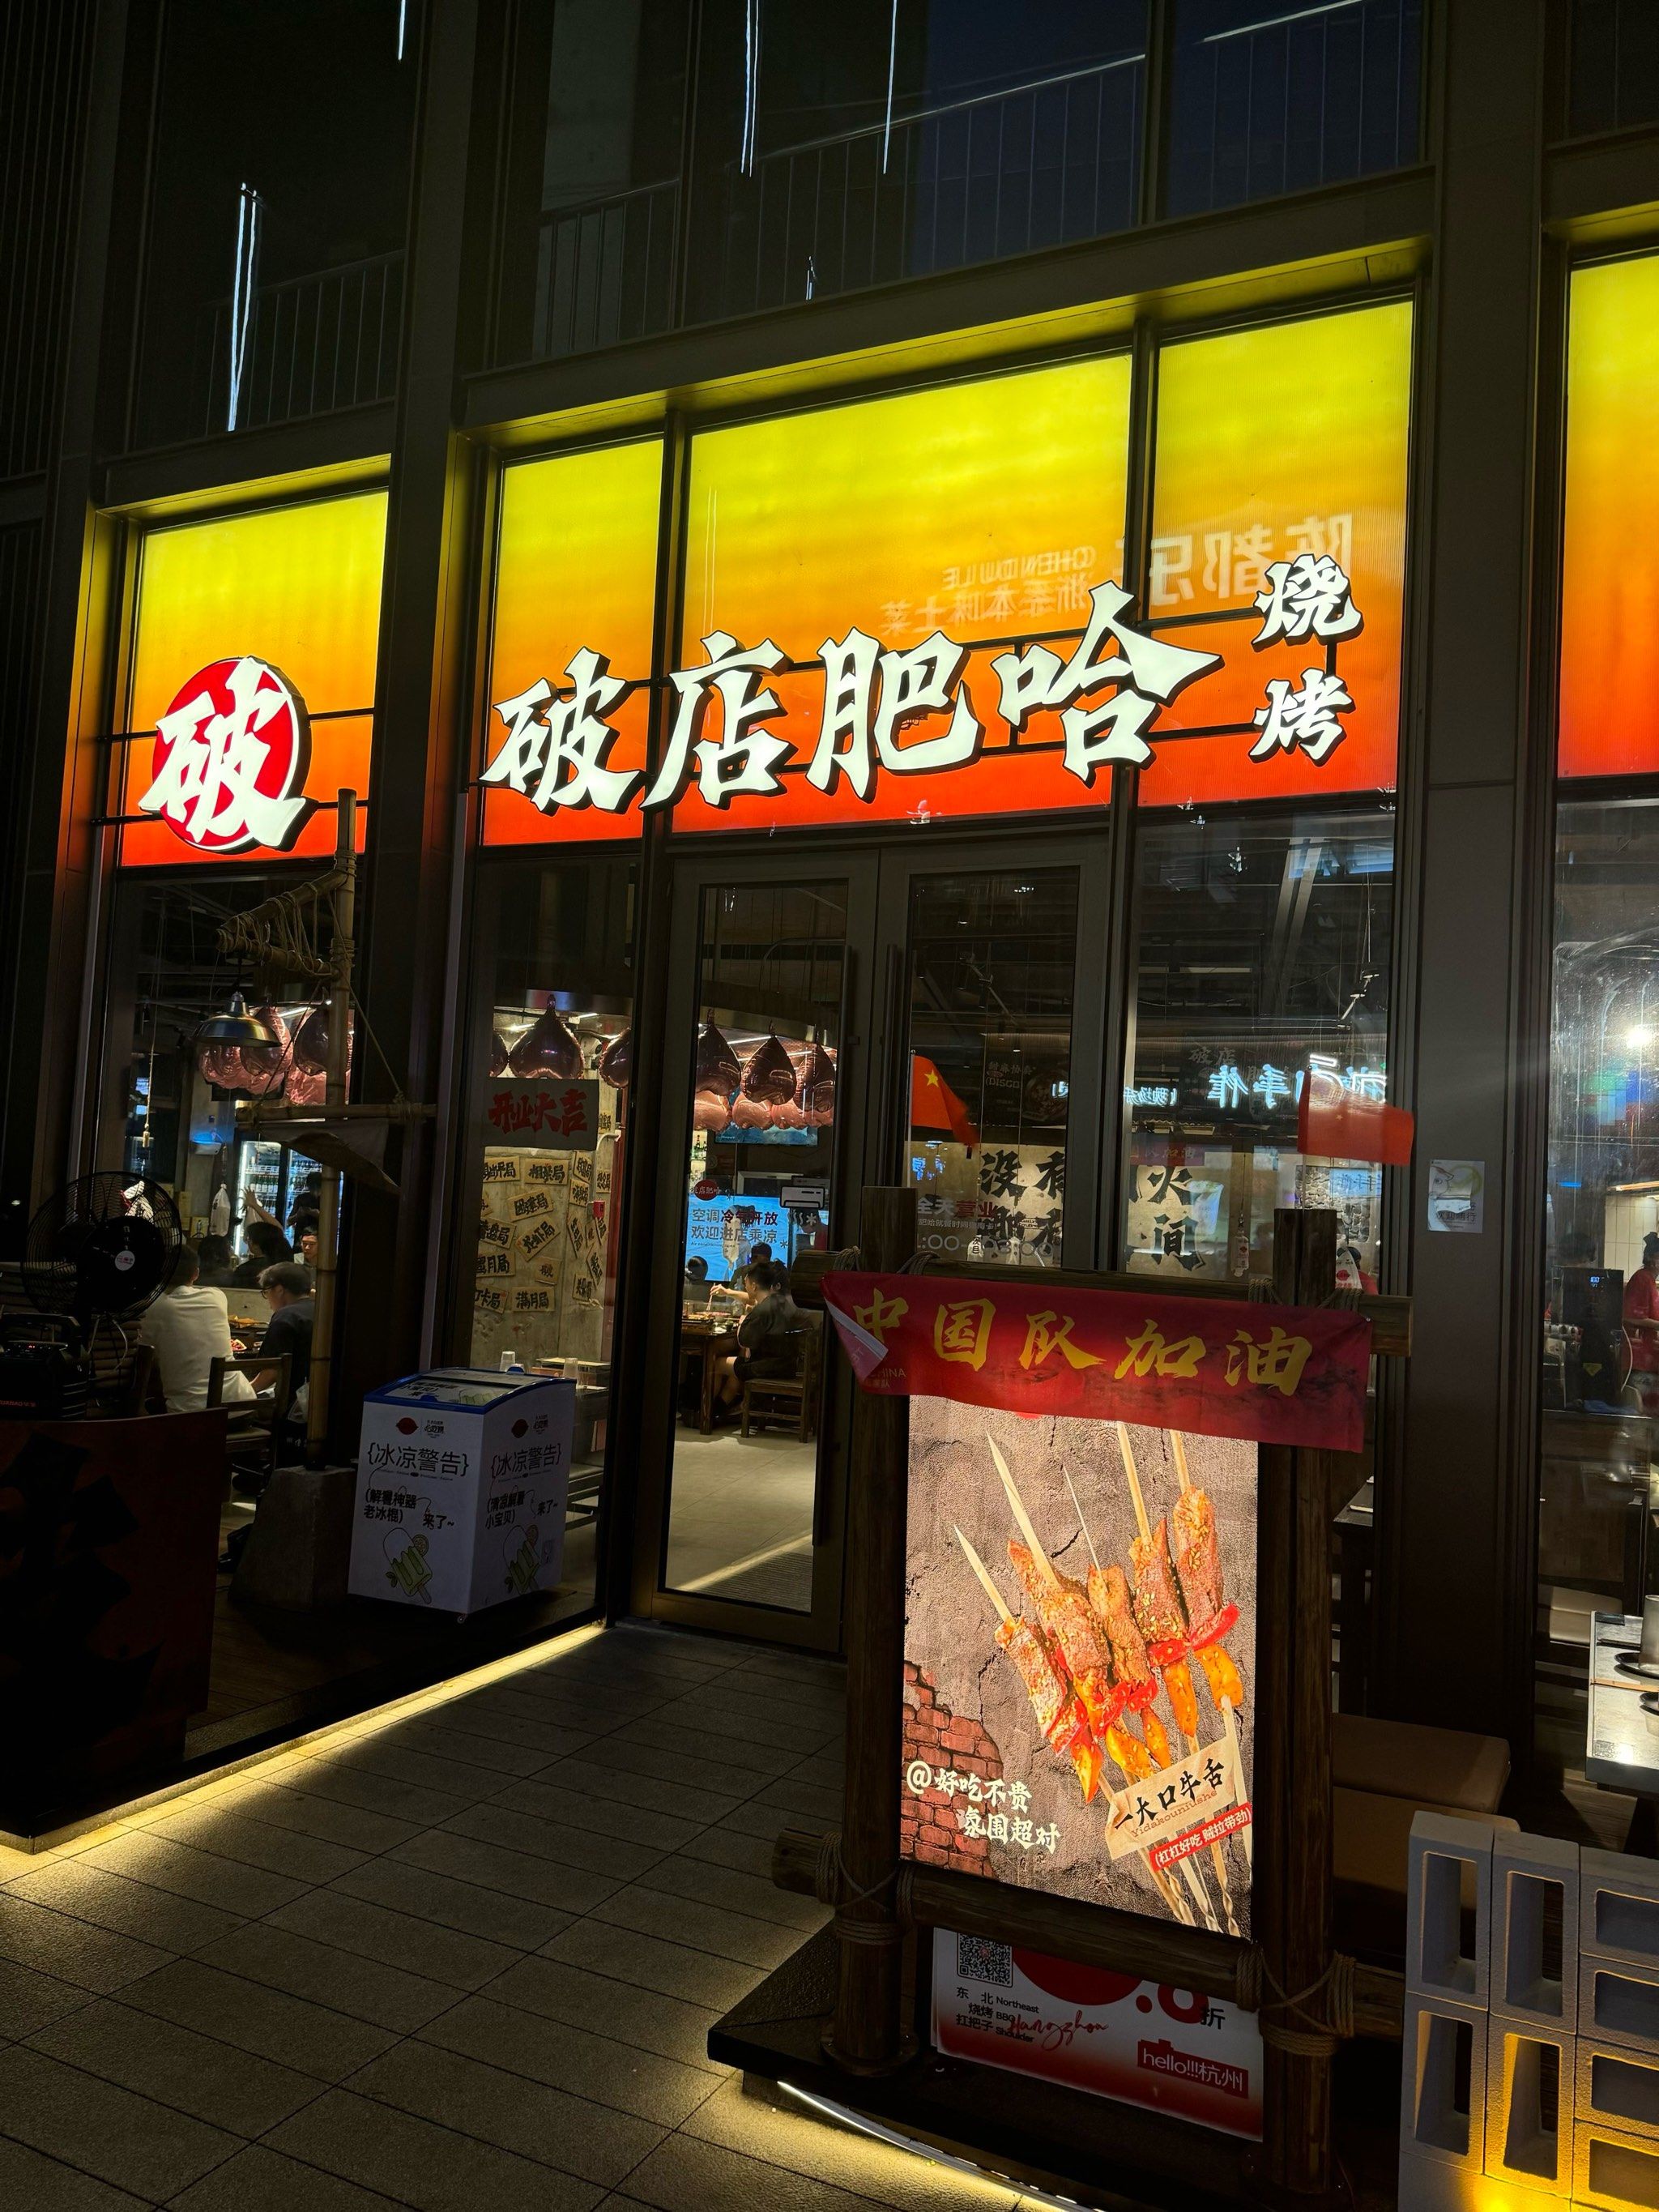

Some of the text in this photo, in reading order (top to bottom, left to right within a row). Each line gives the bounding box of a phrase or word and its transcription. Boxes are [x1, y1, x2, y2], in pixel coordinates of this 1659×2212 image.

[1249, 553, 1363, 765] 烧烤
[479, 580, 1223, 813] 破店肥哈
[139, 655, 308, 849] 破
[488, 1088, 589, 1137] 开业大吉
[692, 1207, 778, 1227] 空调冷气开放
[917, 1196, 1000, 1219] 全天营业
[690, 1226, 778, 1244] 欢迎进店乘凉
[852, 1287, 1313, 1397] 中国队加油
[1113, 1756, 1225, 1831] 一大口牛舌
[1130, 1789, 1218, 1838] Yidakouniushe
[956, 2013, 994, 2032] 扛把子
[968, 2002, 994, 2020] 烧烤
[996, 1996, 1039, 2015] Northeast
[996, 2026, 1034, 2044] Shoulder
